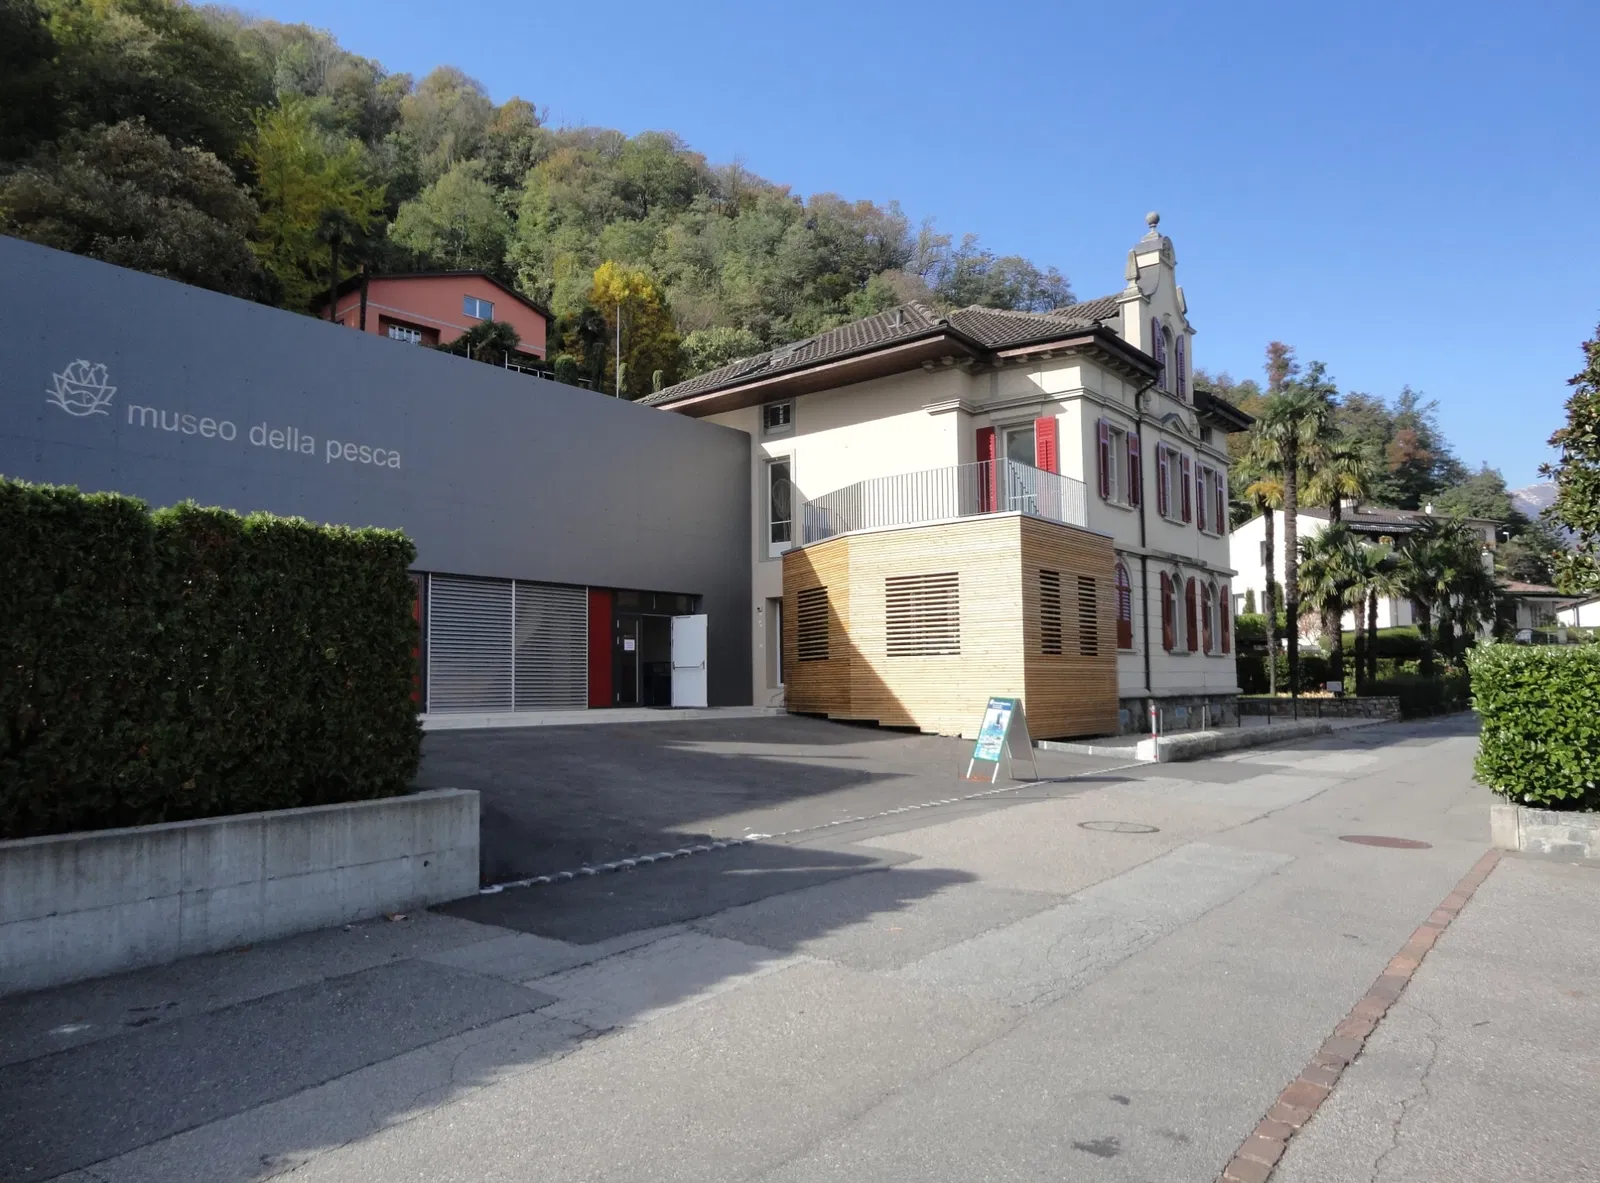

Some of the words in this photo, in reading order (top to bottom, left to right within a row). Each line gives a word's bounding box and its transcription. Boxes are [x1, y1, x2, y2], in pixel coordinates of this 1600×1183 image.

[128, 404, 237, 441] museo
[249, 422, 315, 455] della
[326, 439, 401, 469] pesca
